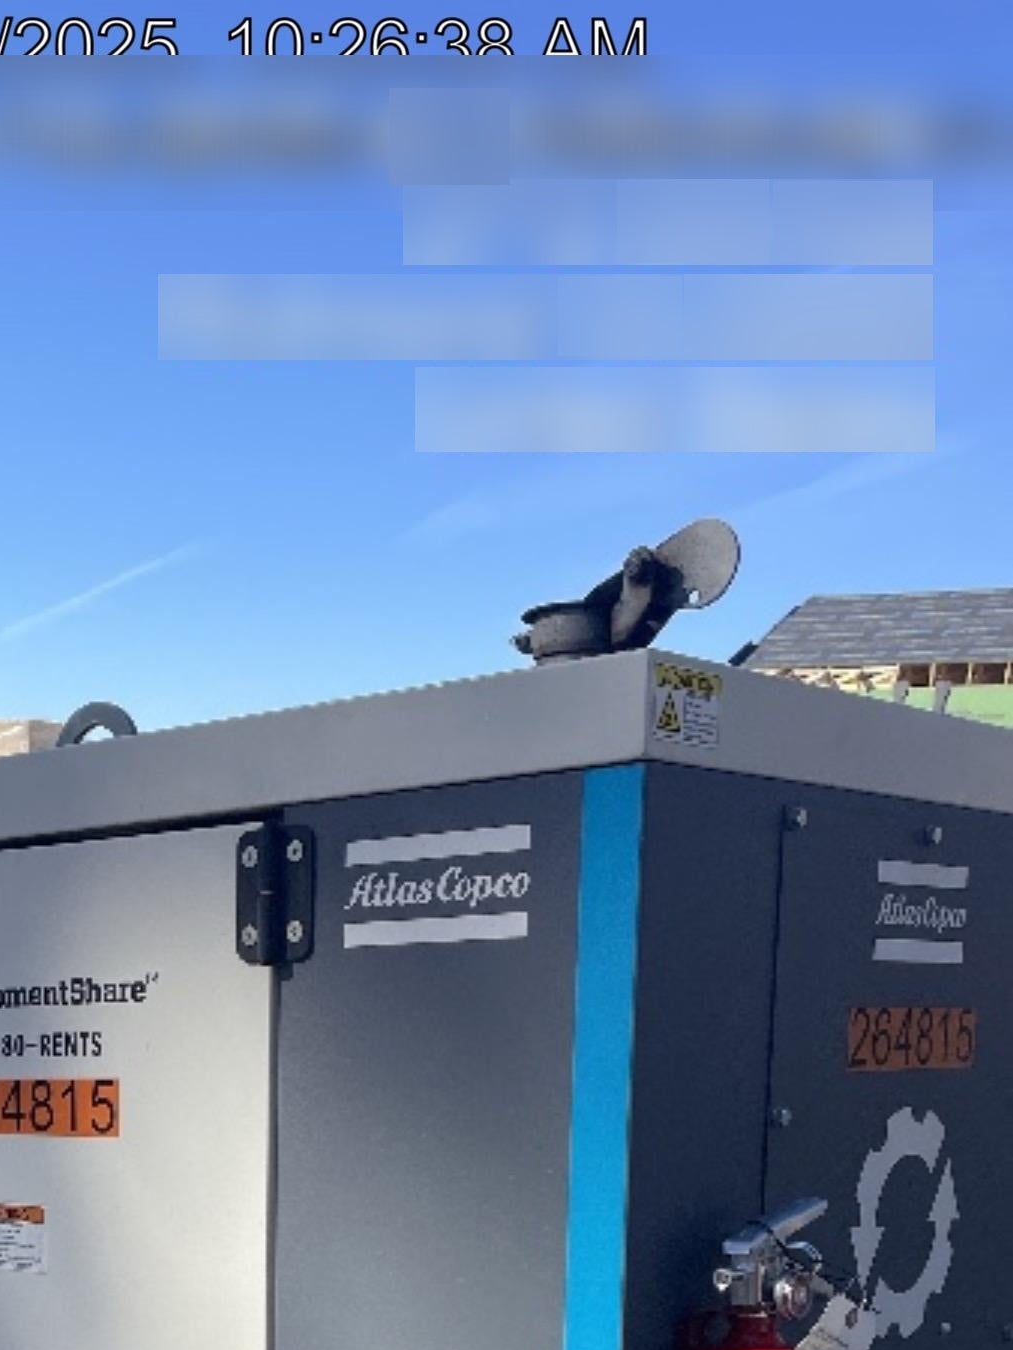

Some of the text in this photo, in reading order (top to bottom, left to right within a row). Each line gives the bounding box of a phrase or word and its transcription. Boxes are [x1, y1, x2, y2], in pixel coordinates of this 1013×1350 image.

[343, 866, 531, 910] Atlas Copco
[850, 1008, 973, 1067] 264815
